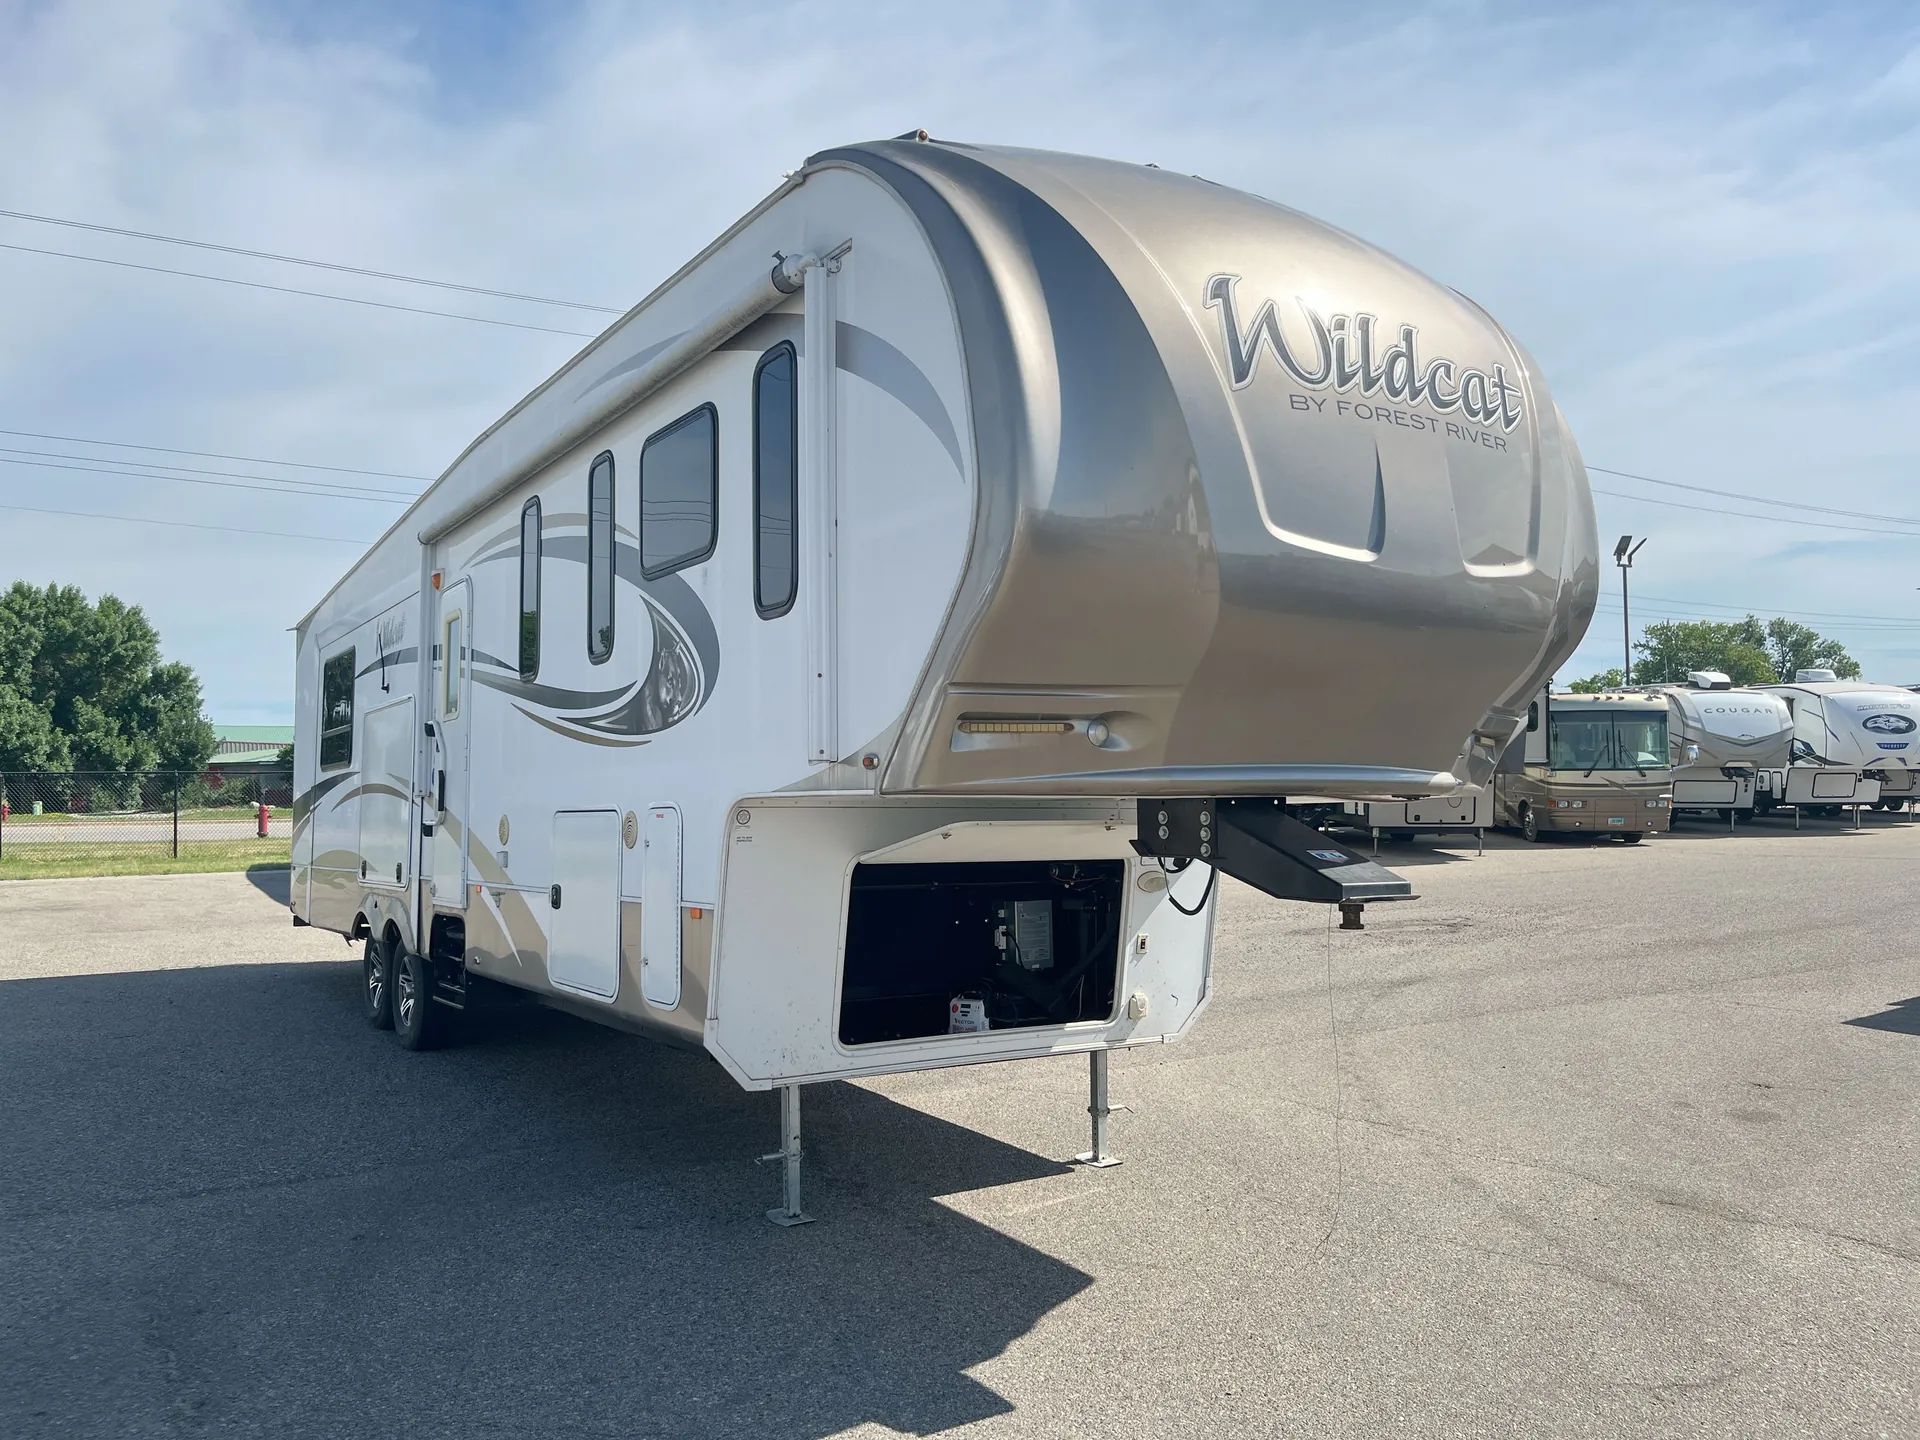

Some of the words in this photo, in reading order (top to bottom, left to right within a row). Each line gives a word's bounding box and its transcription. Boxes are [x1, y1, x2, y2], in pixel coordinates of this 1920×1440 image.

[1203, 272, 1523, 434] Wildcat
[1289, 393, 1327, 413] BY
[1336, 400, 1440, 433] FOREST
[1445, 421, 1508, 453] RIVER
